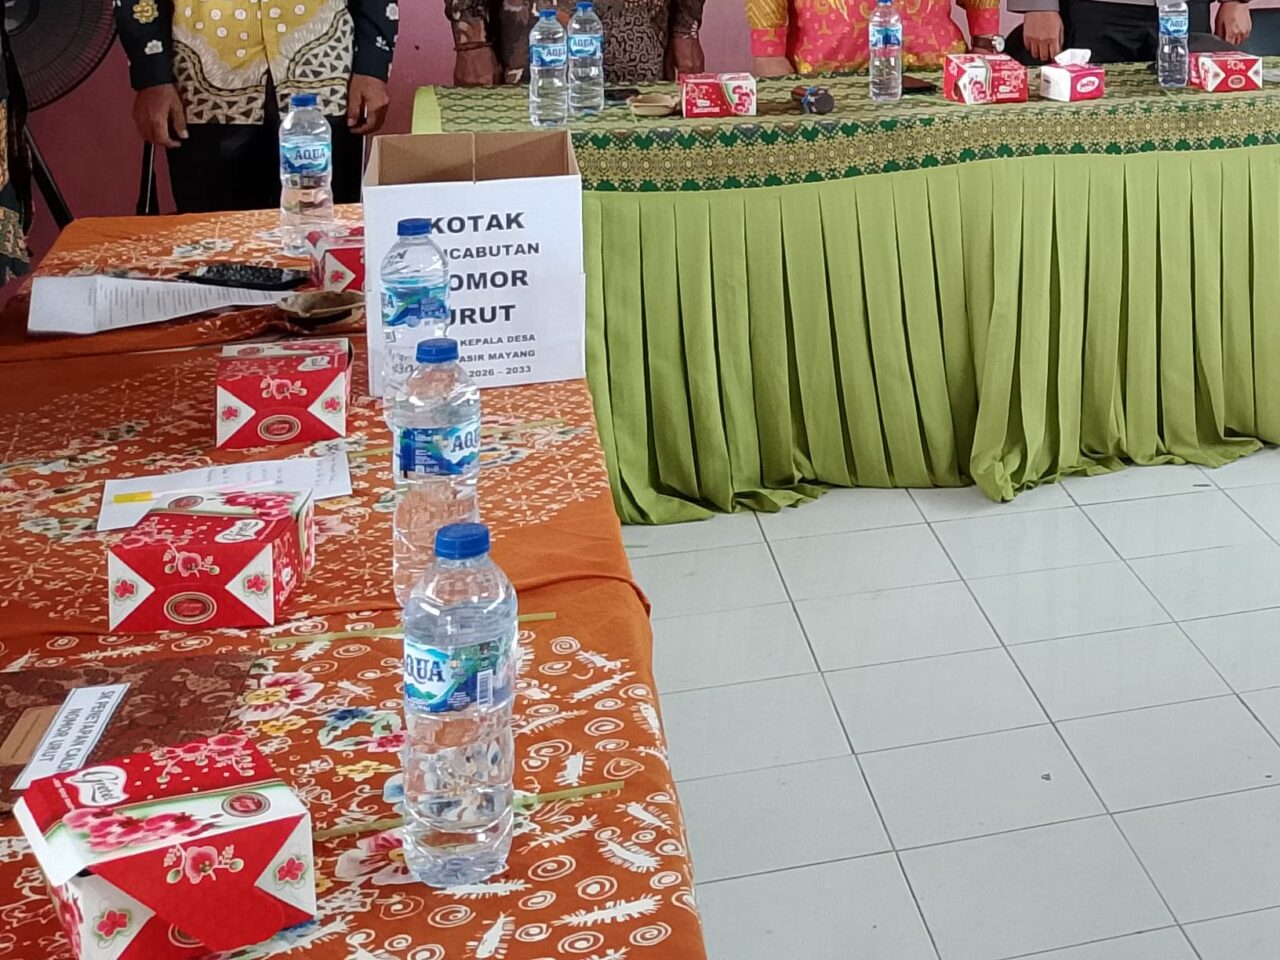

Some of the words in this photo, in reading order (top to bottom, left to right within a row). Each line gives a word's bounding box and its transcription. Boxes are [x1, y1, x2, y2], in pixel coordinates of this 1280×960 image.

[295, 148, 325, 162] AQUA
[429, 212, 525, 234] KOTAK
[444, 242, 540, 260] CABUTAN
[449, 269, 529, 292] OMOR
[460, 336, 503, 347] KEPALA
[507, 333, 536, 343] DESA
[459, 353, 484, 363] ASIR
[488, 349, 536, 361] MAYANG
[468, 368, 495, 378] 2026
[506, 365, 532, 375] 2033
[406, 653, 446, 685] QUA
[98, 690, 116, 701] SK
[52, 707, 84, 739] NOMOR
[70, 700, 110, 747] PENETAPAN
[38, 739, 65, 762] URUT
